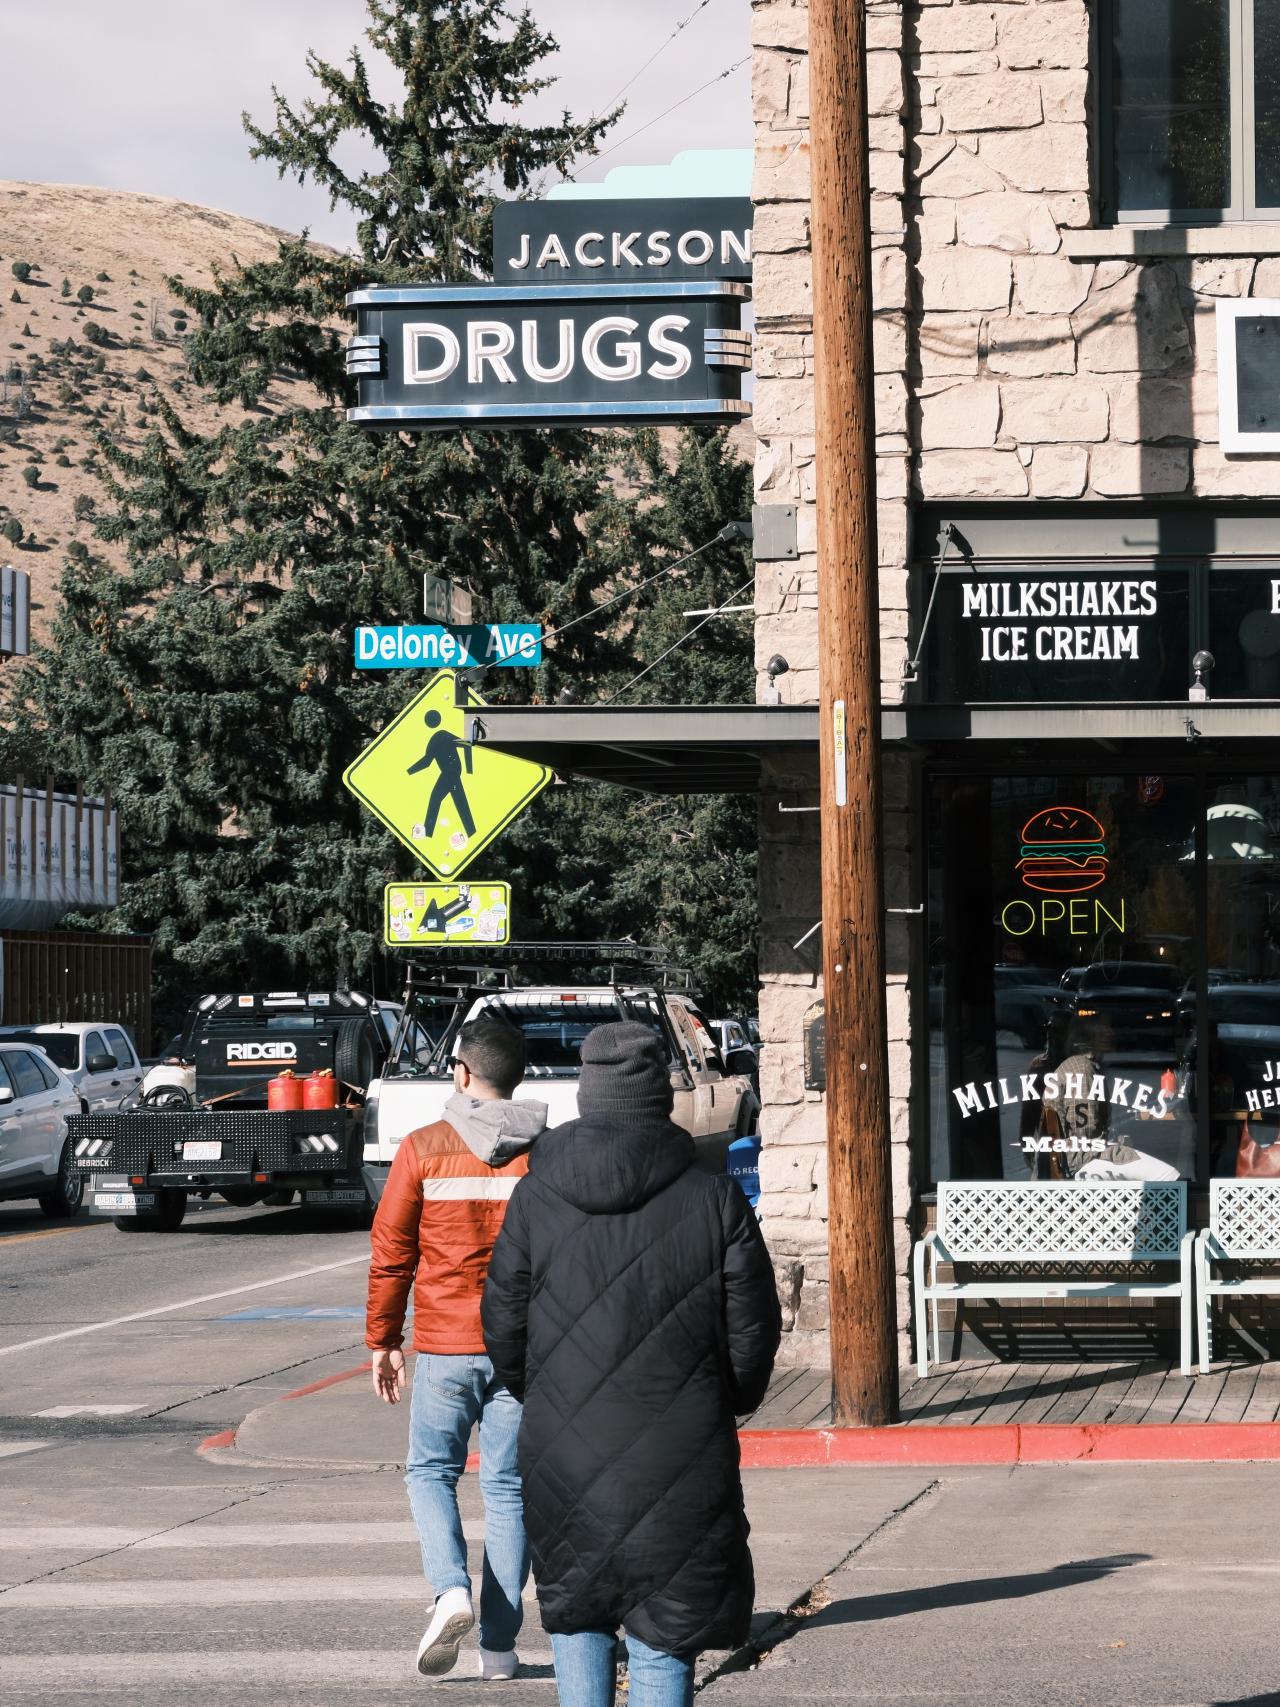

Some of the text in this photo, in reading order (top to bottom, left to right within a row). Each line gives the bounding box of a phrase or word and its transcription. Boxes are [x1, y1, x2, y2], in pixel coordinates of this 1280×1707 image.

[508, 229, 752, 269] JACKSON
[402, 314, 692, 385] DRUGS
[962, 580, 1158, 618] MILKSHAKES
[359, 626, 537, 665] Deloney Ave
[980, 625, 1140, 661] ICE CREAM
[1001, 897, 1126, 937] OPEN
[226, 1042, 297, 1060] RIDGID
[952, 1072, 1170, 1120] MILKSHAKES
